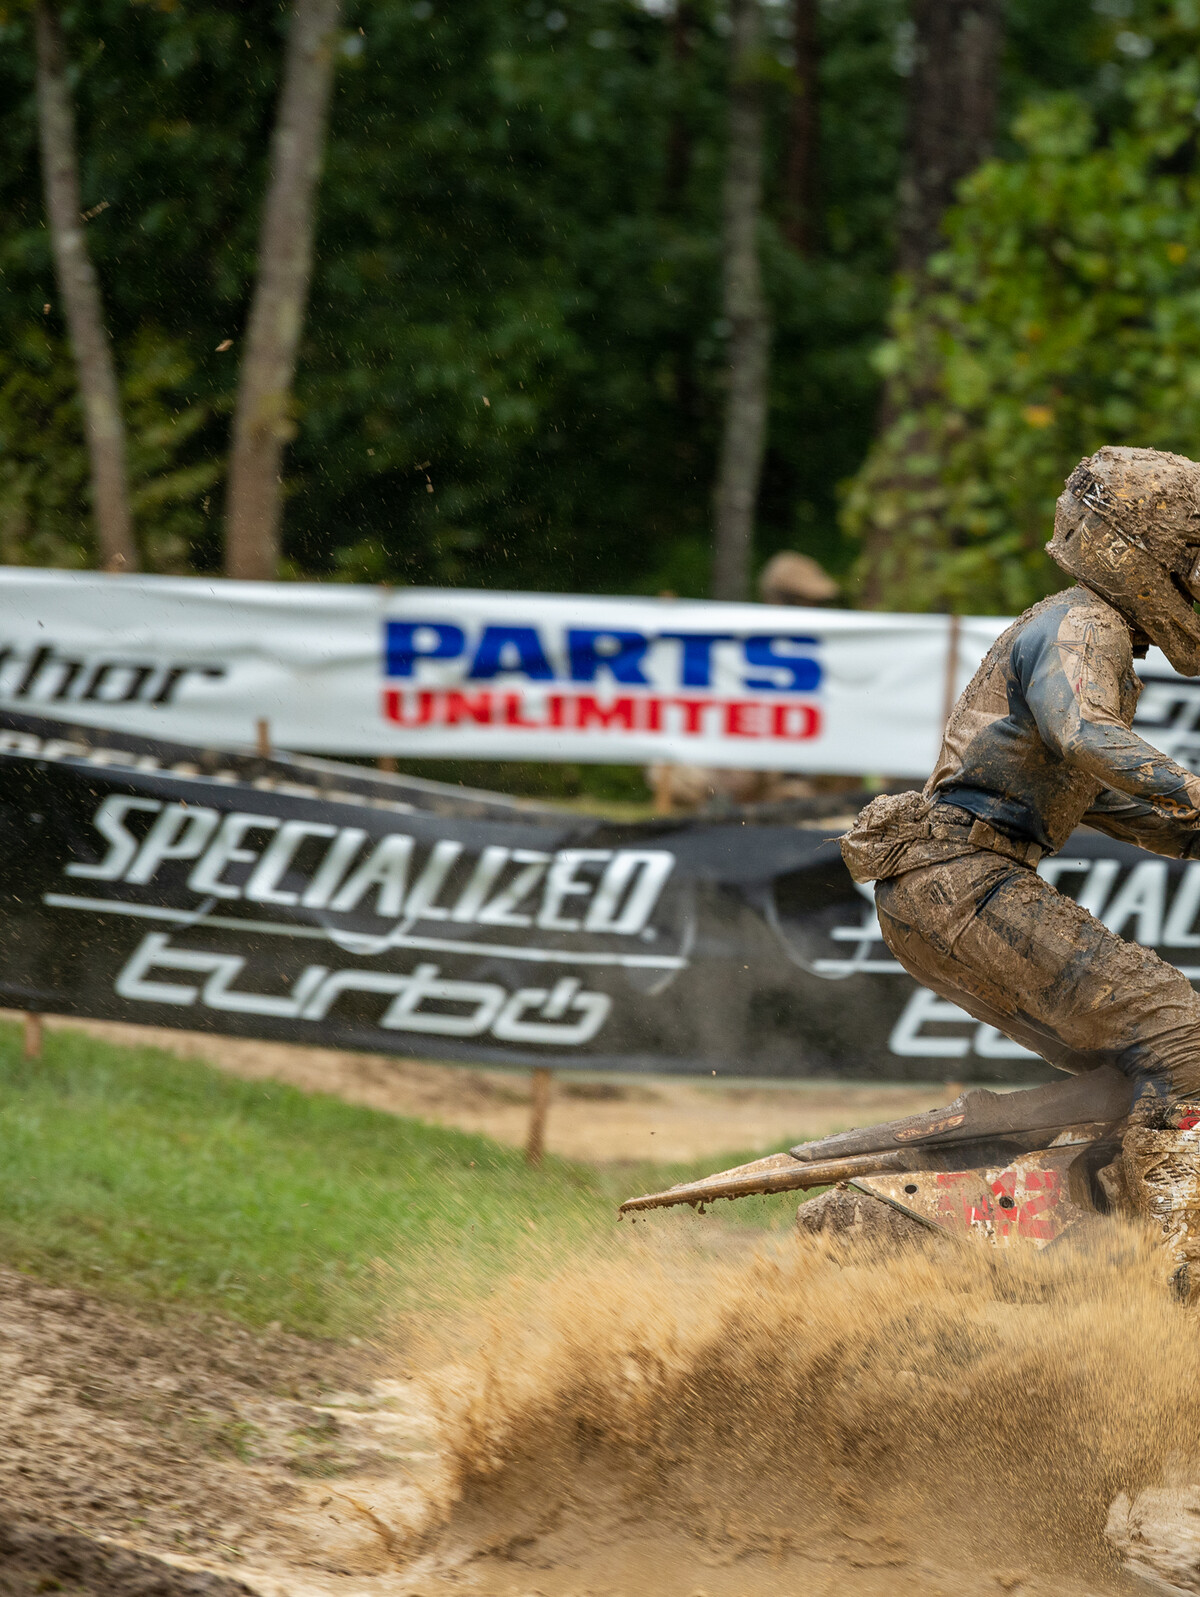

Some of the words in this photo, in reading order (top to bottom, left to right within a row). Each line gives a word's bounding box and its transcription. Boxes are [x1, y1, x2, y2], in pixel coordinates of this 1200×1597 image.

[0, 645, 226, 705] hor
[383, 618, 824, 694] PARTS
[382, 689, 823, 741] UNLIMITED
[66, 794, 676, 934] SPECIALIZED
[114, 932, 613, 1046] turbo
